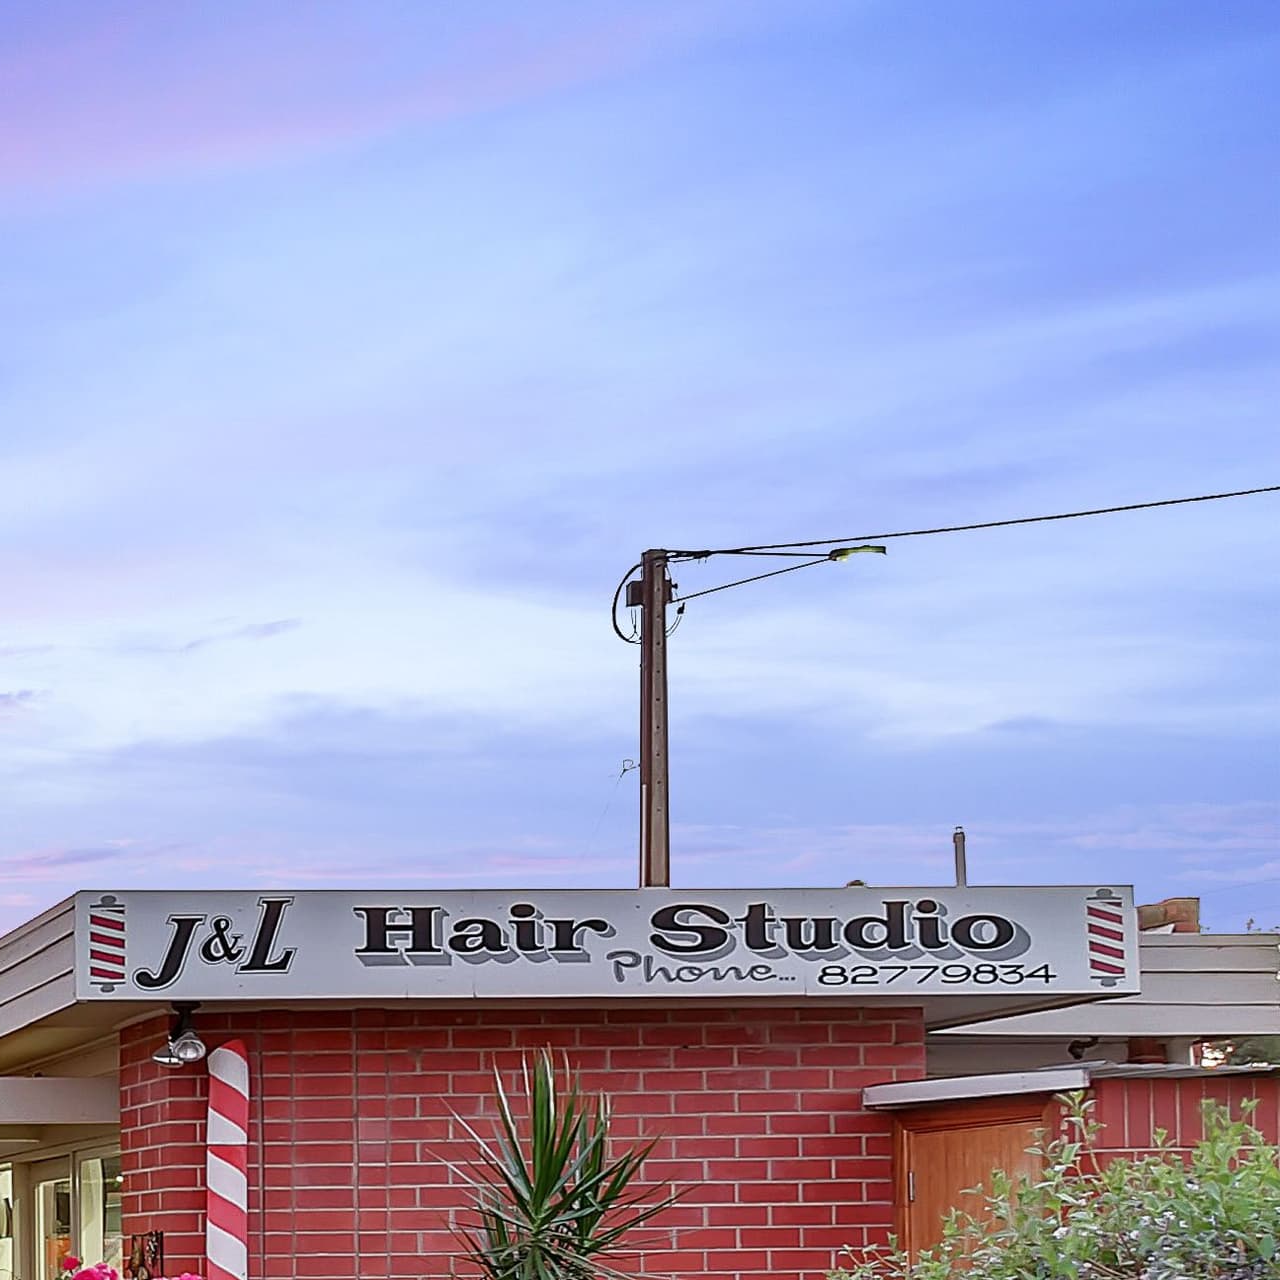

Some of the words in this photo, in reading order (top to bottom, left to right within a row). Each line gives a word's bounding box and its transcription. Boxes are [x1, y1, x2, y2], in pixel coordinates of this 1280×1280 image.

[133, 896, 297, 992] J&L
[353, 902, 614, 964] Hair
[648, 899, 1029, 961] Studio
[817, 962, 1058, 986] 82779834
